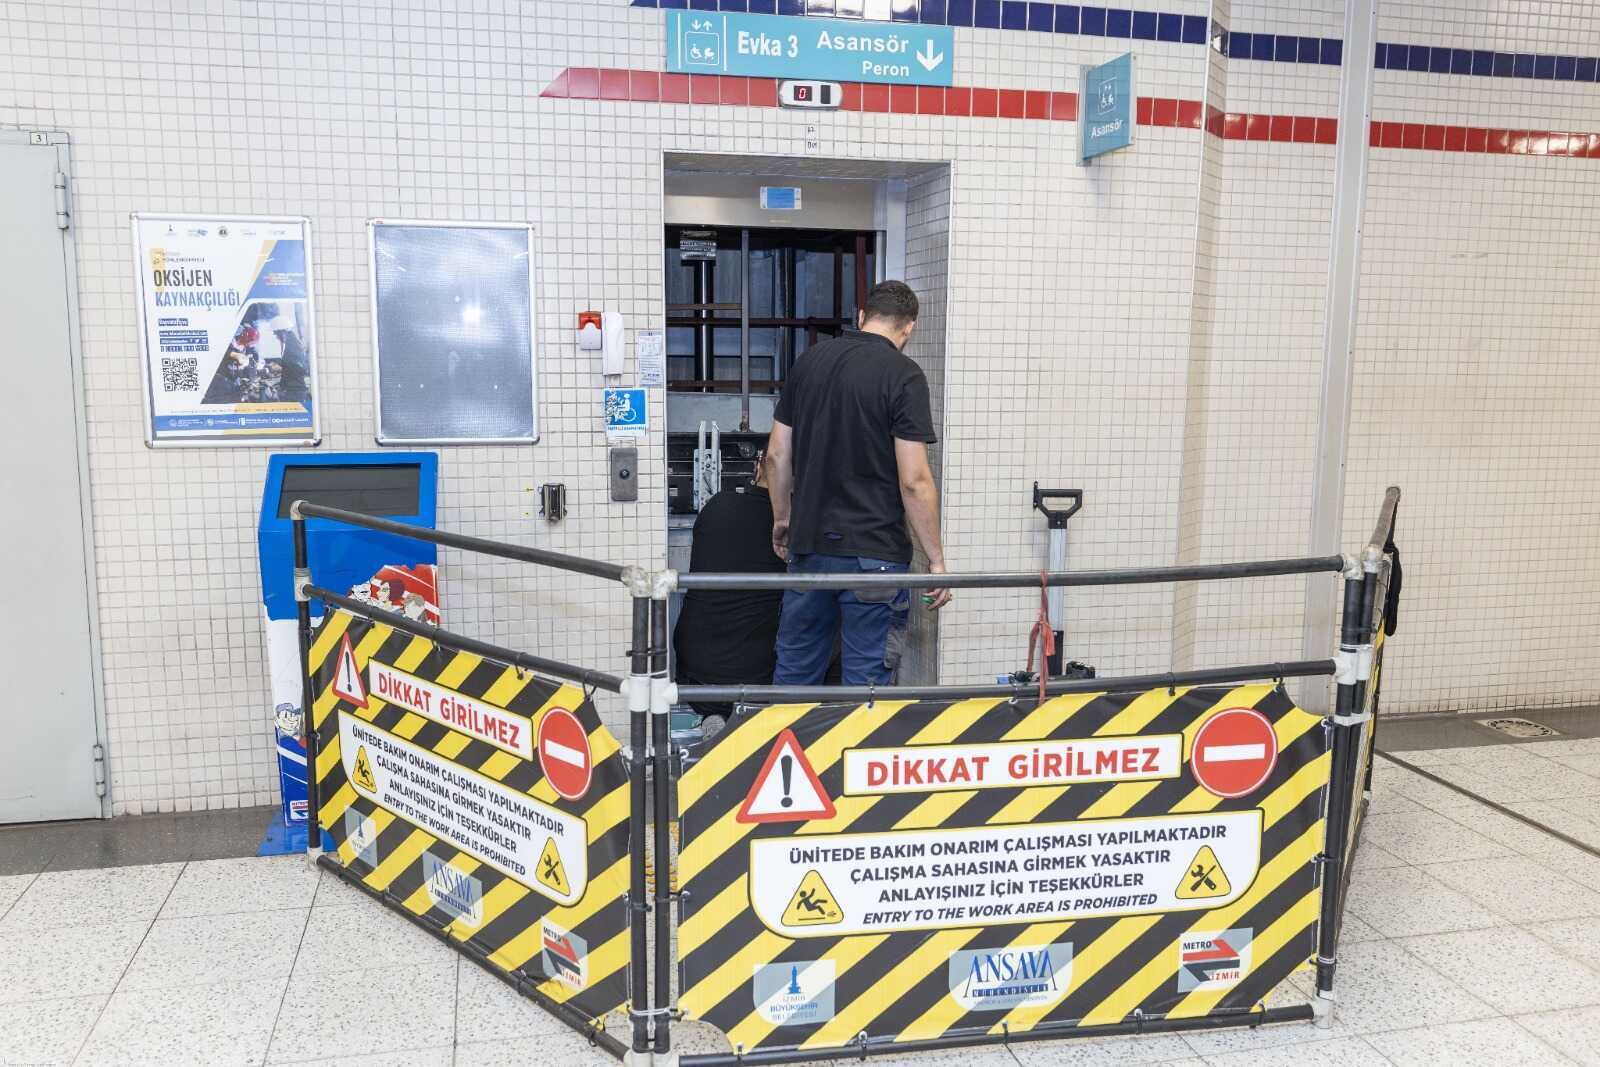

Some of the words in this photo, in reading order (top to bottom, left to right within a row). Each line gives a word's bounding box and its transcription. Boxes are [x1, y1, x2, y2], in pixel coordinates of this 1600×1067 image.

[737, 30, 782, 57] Evka
[787, 35, 799, 58] 3
[816, 30, 909, 54] Asansör
[862, 60, 910, 77] Peron
[798, 87, 808, 99] 0
[36, 134, 42, 143] 3
[1091, 119, 1124, 139] Asansör
[153, 267, 213, 287] OKSİJEN
[155, 289, 240, 312] KAYNAKÇILIĞI
[378, 672, 432, 713] DİKKAT
[440, 696, 521, 749] GİRİLMEZ
[352, 724, 382, 747] ÜNİTEDE
[383, 739, 407, 760] BAKIM
[408, 754, 440, 777] ONARIM
[441, 769, 487, 800] ÇALIŞMASI
[488, 789, 565, 837] YAPILMAKTADIR
[867, 754, 990, 787] DİKKAT
[1008, 746, 1160, 780] GİRİLMEZ
[376, 755, 409, 781] ÇALIŞMA
[410, 771, 450, 800] SAHASINA
[452, 791, 485, 817] GİRMEK
[486, 808, 532, 841] YASAKTIR
[389, 779, 436, 812] ANLAYIŞINIZ
[437, 801, 454, 822] İÇİN
[455, 812, 517, 854] TEŞEKKÜRLER
[383, 794, 404, 812] ENTRY
[404, 804, 414, 816] TO
[415, 809, 428, 824] THE
[429, 816, 450, 836] WORK
[451, 827, 471, 846] AREA
[480, 843, 526, 876] PROHIBITED
[789, 845, 866, 864] ÜNİTEDE
[870, 842, 926, 860] BAKIM
[930, 839, 999, 857] ONARIM
[1003, 833, 1093, 854] ÇALIŞMASI
[1097, 825, 1227, 846] YAPILMAKTADIR
[850, 864, 927, 884] ÇALIŞMA
[931, 859, 1019, 878] SAHASINA
[1023, 854, 1087, 872] GİRMEK
[1091, 850, 1171, 867] YASAKTIR
[878, 883, 985, 904] ANLAYIŞINIZ
[990, 878, 1024, 898] İÇİN
[1028, 872, 1144, 895] TEŞEKKÜRLER
[862, 910, 912, 926] ENTRY
[915, 908, 934, 922] TO
[937, 906, 965, 920] THE
[968, 903, 1013, 918] WORK
[1015, 900, 1054, 916] AREA
[1057, 898, 1071, 913] IS
[1074, 893, 1158, 912] PROHIBITED
[544, 925, 563, 943] METRO
[1183, 940, 1212, 950] METRO
[963, 949, 1058, 998] ANSAVA
